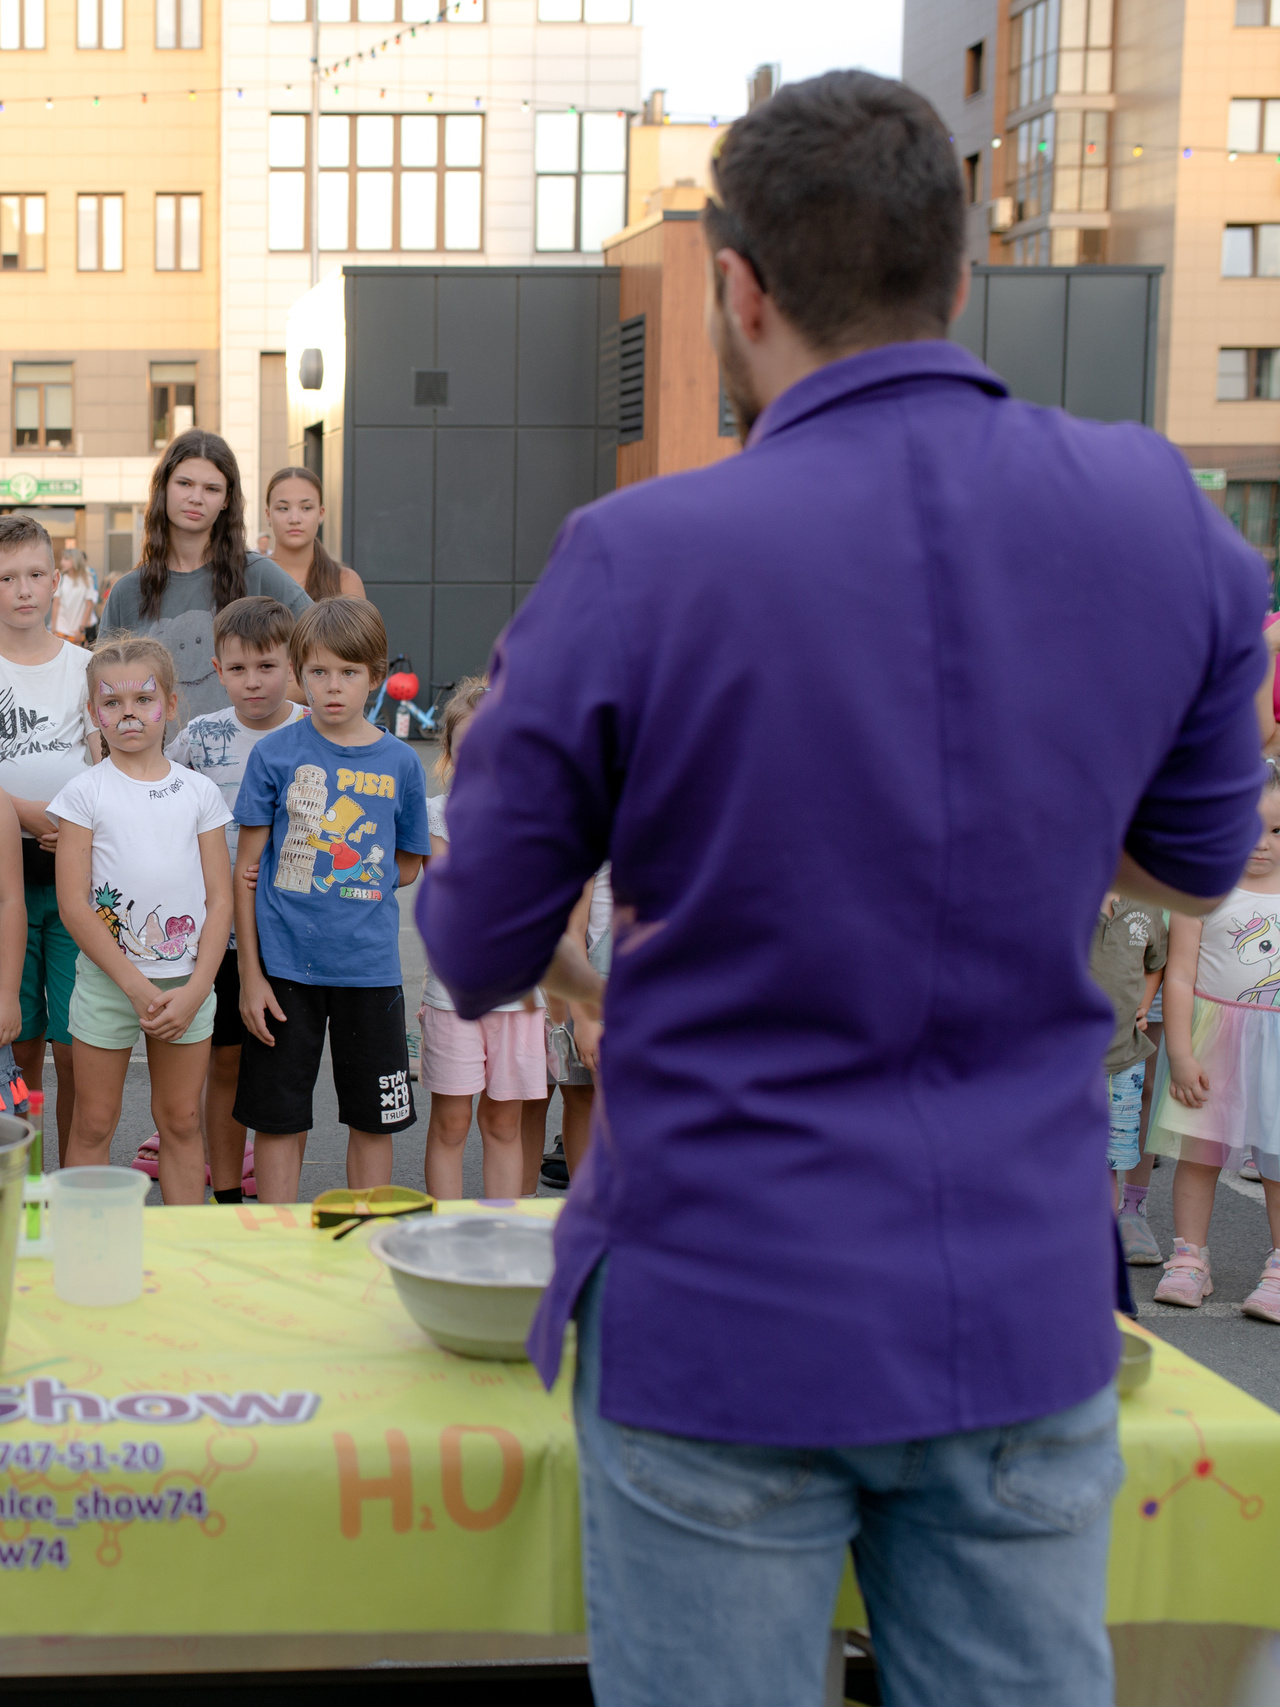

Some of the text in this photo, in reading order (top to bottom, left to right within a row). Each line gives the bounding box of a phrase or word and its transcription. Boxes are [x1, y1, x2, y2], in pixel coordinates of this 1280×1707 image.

[336, 767, 395, 799] PISA
[149, 789, 169, 800] FRUIT
[348, 832, 362, 843] OH
[340, 886, 382, 901] ITALIA
[378, 1070, 407, 1090] STAY
